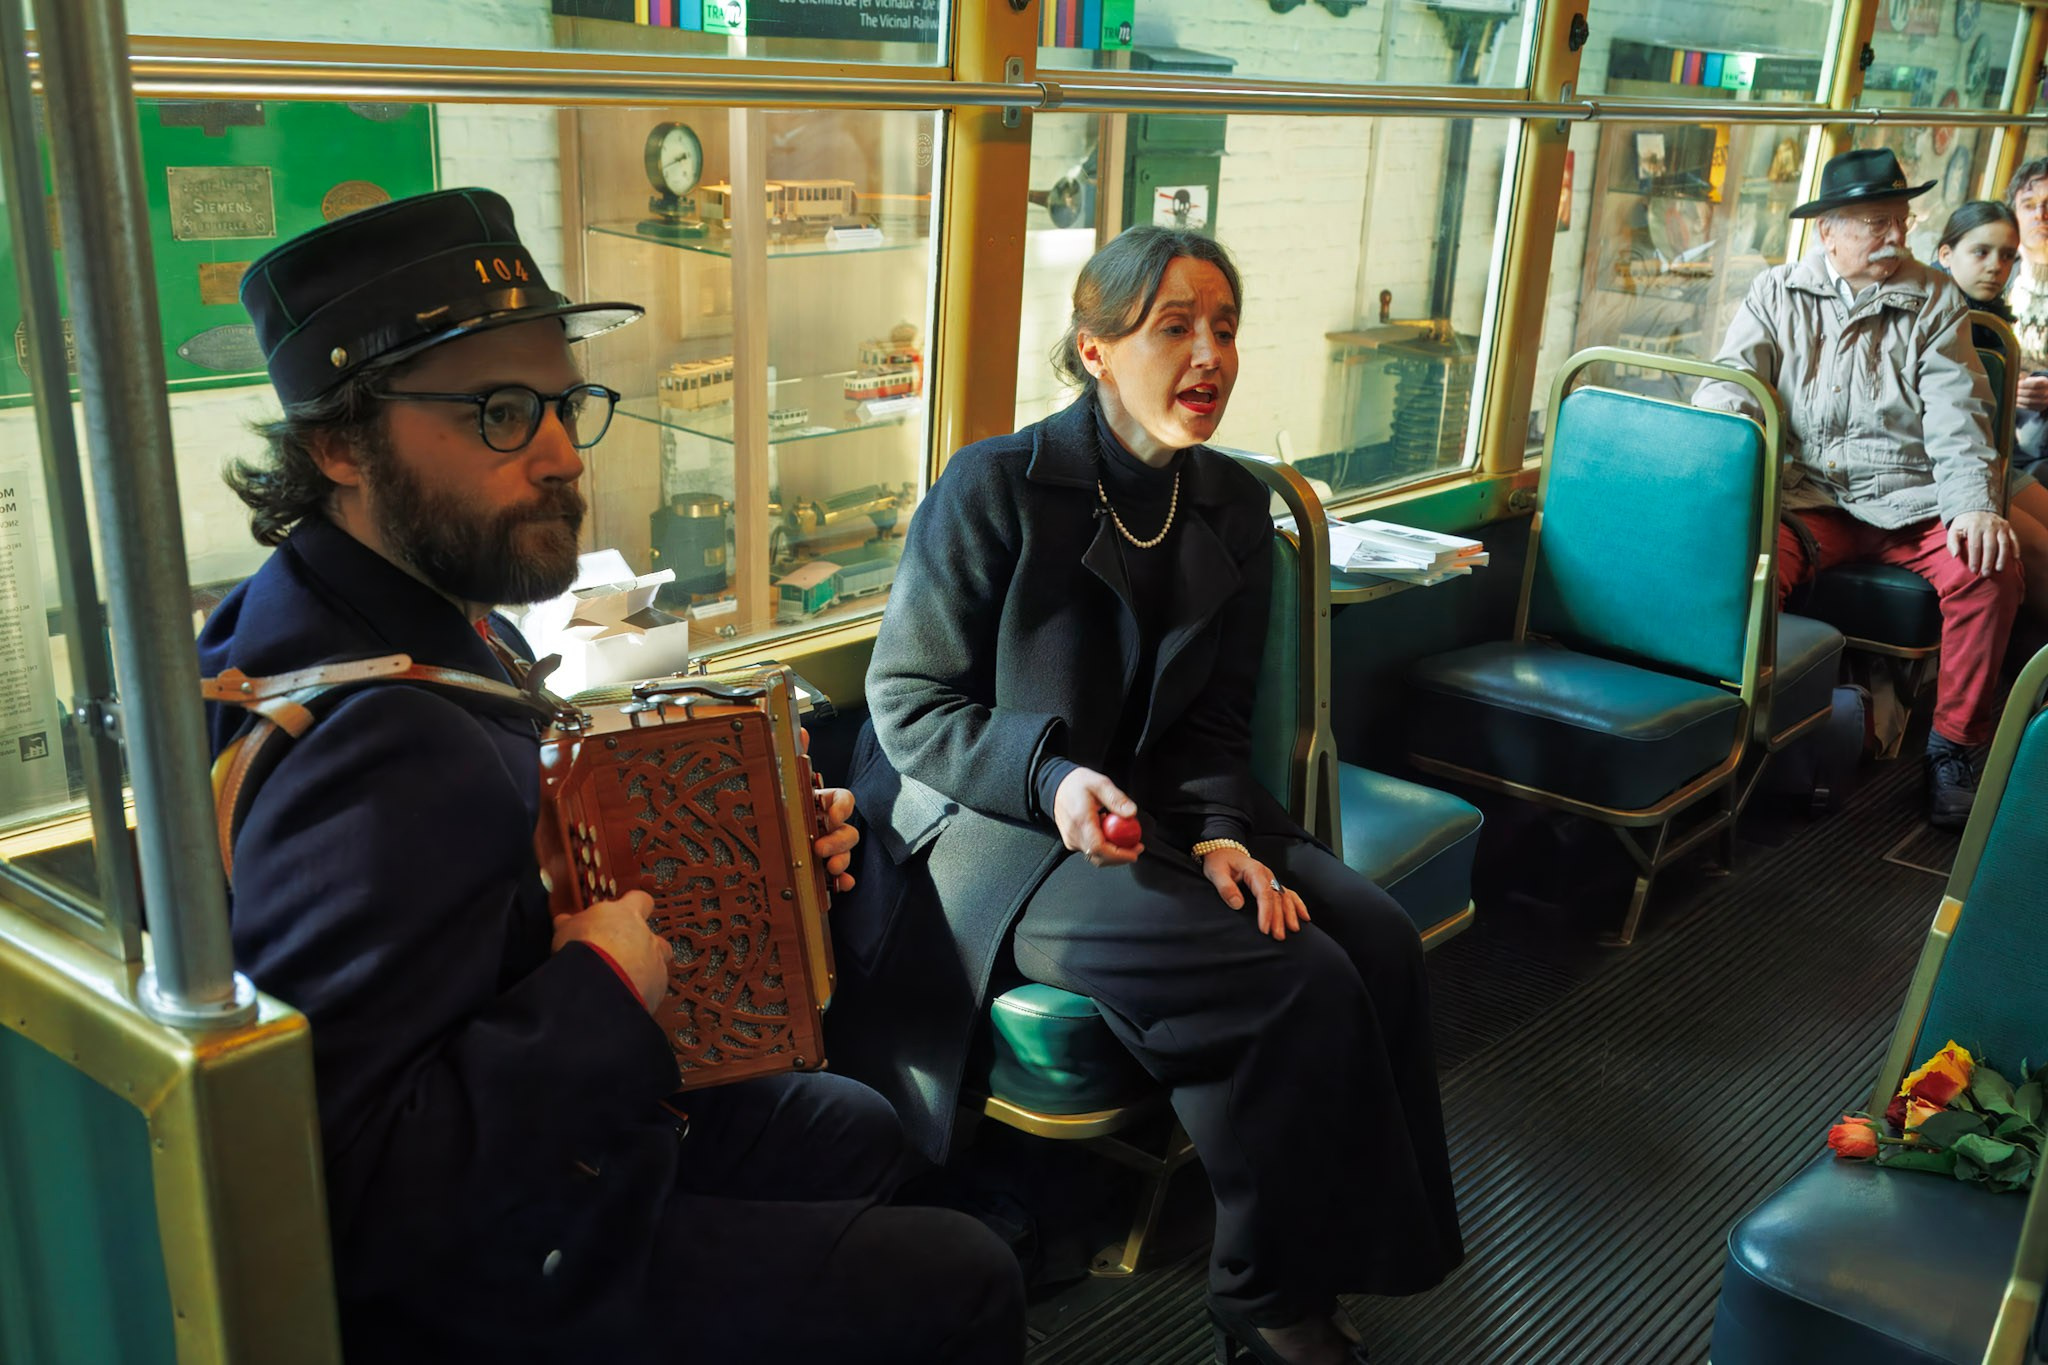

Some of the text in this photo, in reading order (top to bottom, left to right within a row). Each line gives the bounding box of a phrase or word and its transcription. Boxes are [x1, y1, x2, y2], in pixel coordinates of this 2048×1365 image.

[859, 12, 879, 28] The
[879, 14, 911, 29] Vicinal
[193, 199, 253, 214] SIEMENS
[475, 258, 529, 284] 104
